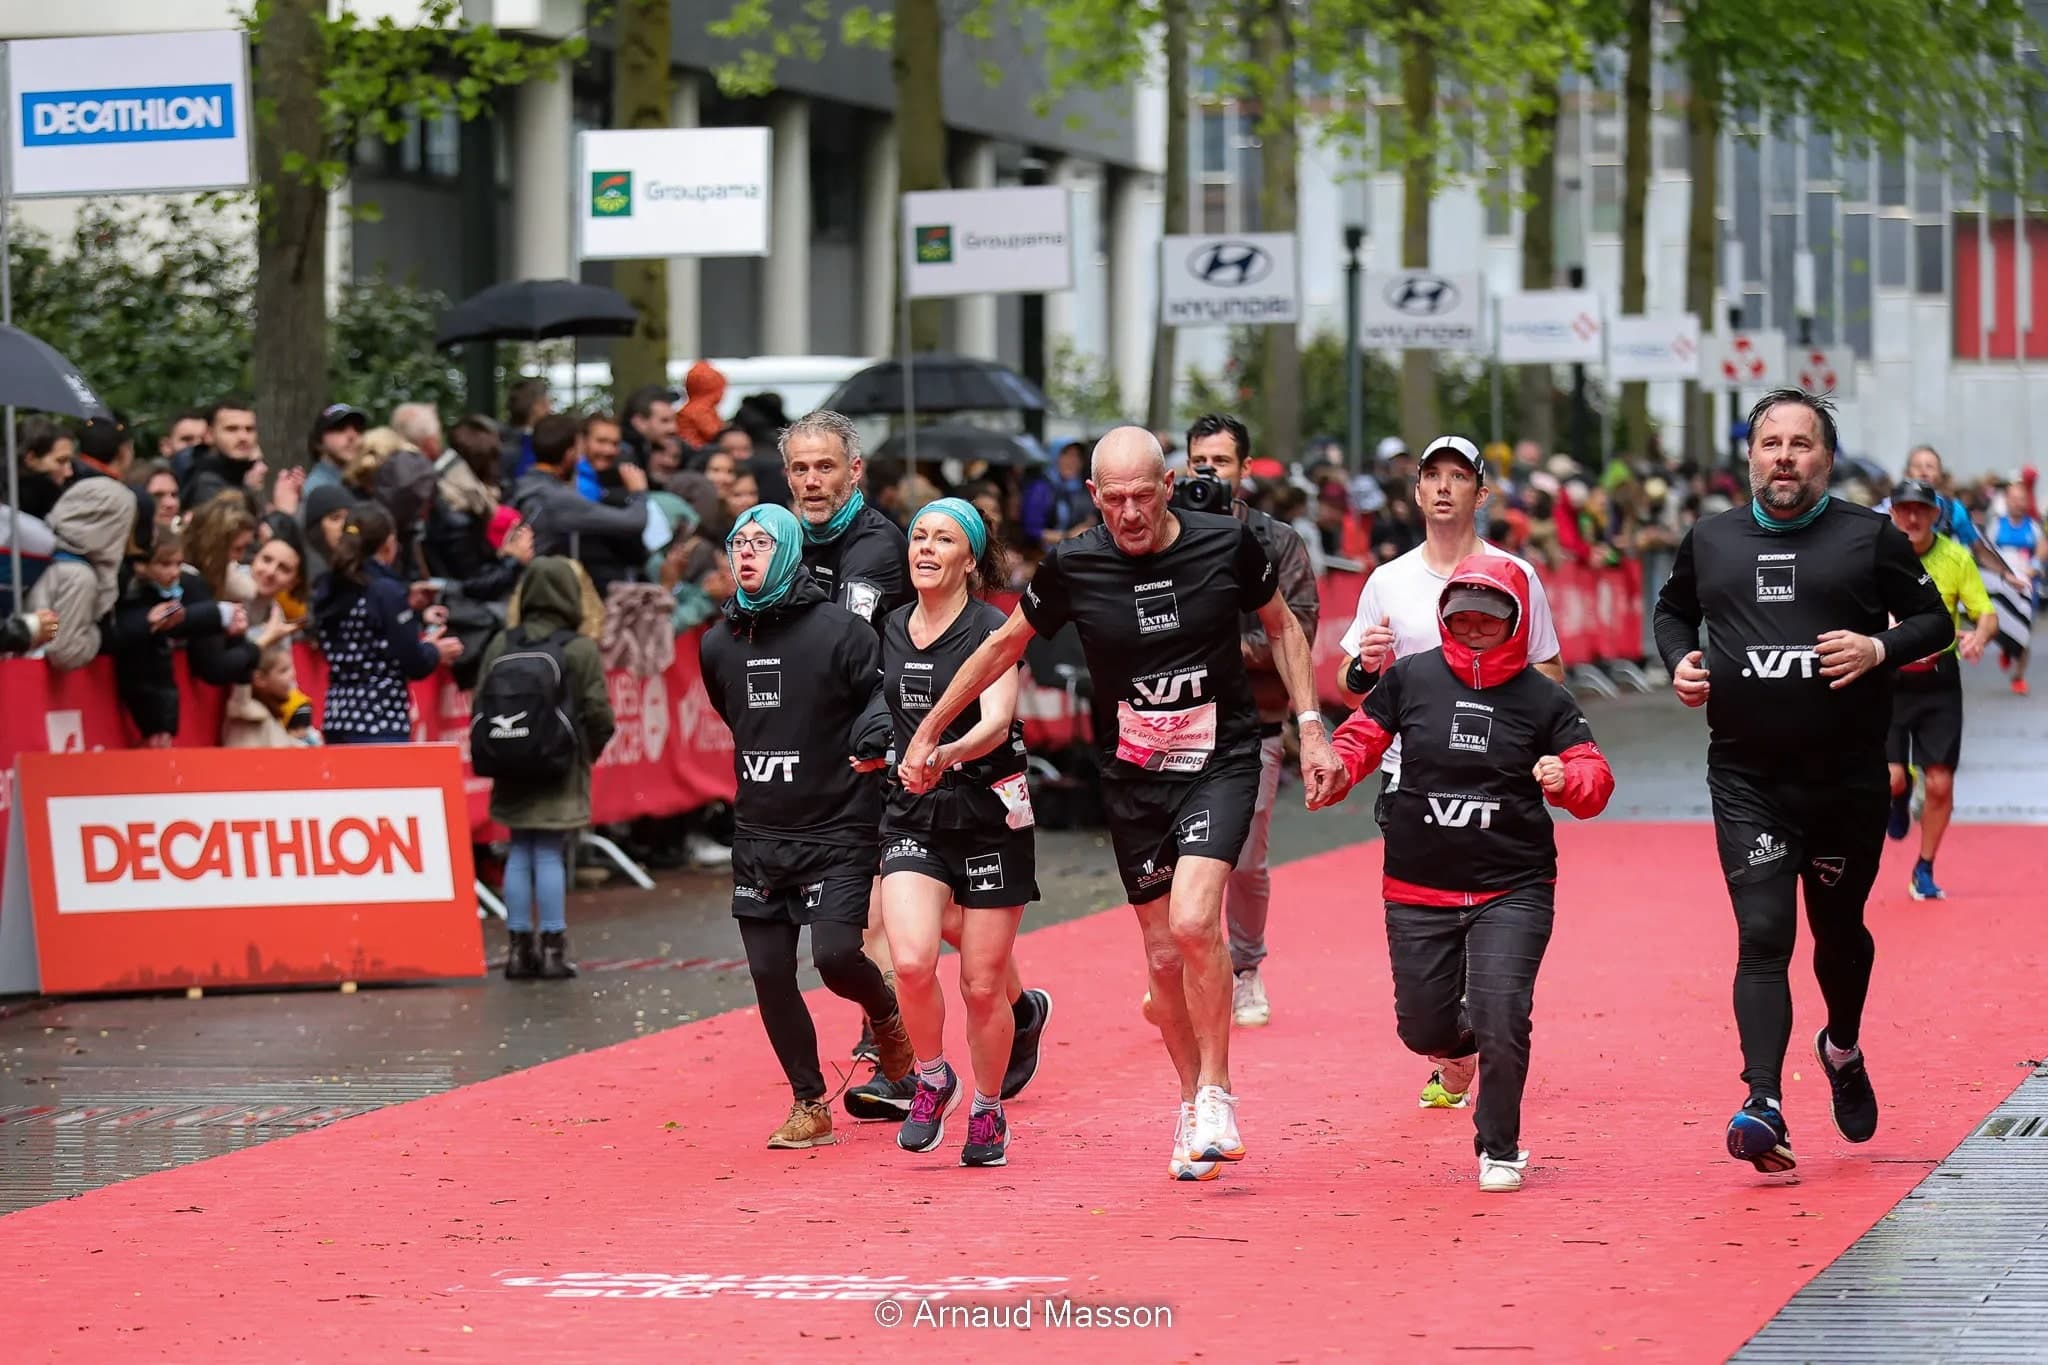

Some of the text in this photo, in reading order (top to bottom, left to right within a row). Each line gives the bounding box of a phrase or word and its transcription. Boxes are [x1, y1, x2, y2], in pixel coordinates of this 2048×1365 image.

[33, 96, 223, 136] DECATHLON
[646, 181, 761, 203] Groupama
[1141, 613, 1177, 627] EXTRA
[749, 692, 779, 701] EXTRA
[902, 693, 930, 703] EXTRA
[1452, 733, 1486, 745] EXTRA
[80, 817, 424, 883] DECATHLON
